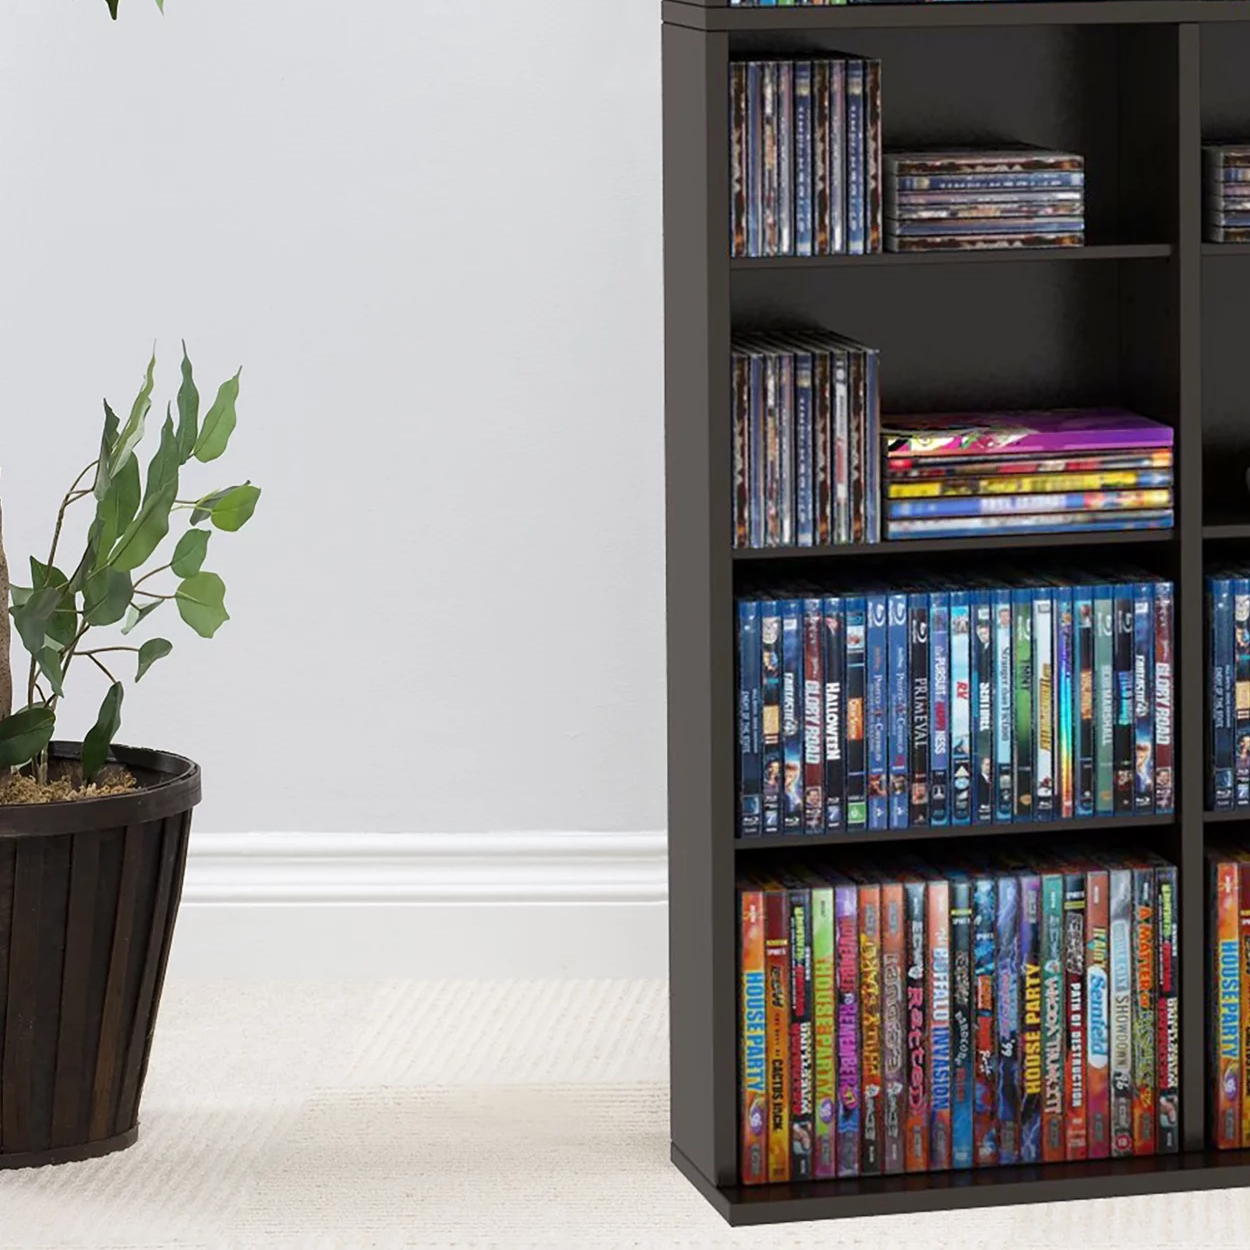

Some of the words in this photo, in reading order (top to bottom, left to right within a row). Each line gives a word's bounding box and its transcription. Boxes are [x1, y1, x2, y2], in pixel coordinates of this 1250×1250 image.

[805, 680, 821, 725] GLORY
[914, 678, 928, 750] PRIMEVAL
[1155, 662, 1171, 706] GLORY
[805, 726, 821, 765] ROAD
[826, 681, 842, 761] HALLOWEEN
[1101, 691, 1113, 746] MARSHALL
[1155, 707, 1171, 746] ROAD
[1137, 904, 1153, 922] A
[931, 947, 949, 1021] BUFFALO
[1137, 923, 1153, 990] MATTER
[1221, 939, 1240, 998] HOUSE
[746, 970, 765, 1029] HOUSE
[815, 960, 834, 1026] HOUSE
[1024, 963, 1040, 1026] PARTY
[1070, 981, 1082, 1009] PATH
[1070, 1013, 1082, 1028] OF
[838, 1003, 858, 1087] REMEMBER
[1114, 991, 1130, 1068] SHOWDOWN
[1221, 1000, 1240, 1060] PARTY
[746, 1031, 765, 1091] PARTY
[771, 1058, 784, 1099] CACTUS
[815, 1031, 834, 1097] PARTY
[931, 1025, 949, 1111] INVASION
[1024, 1031, 1040, 1095] HOUSE
[1070, 1030, 1082, 1108] DESTRUCTION
